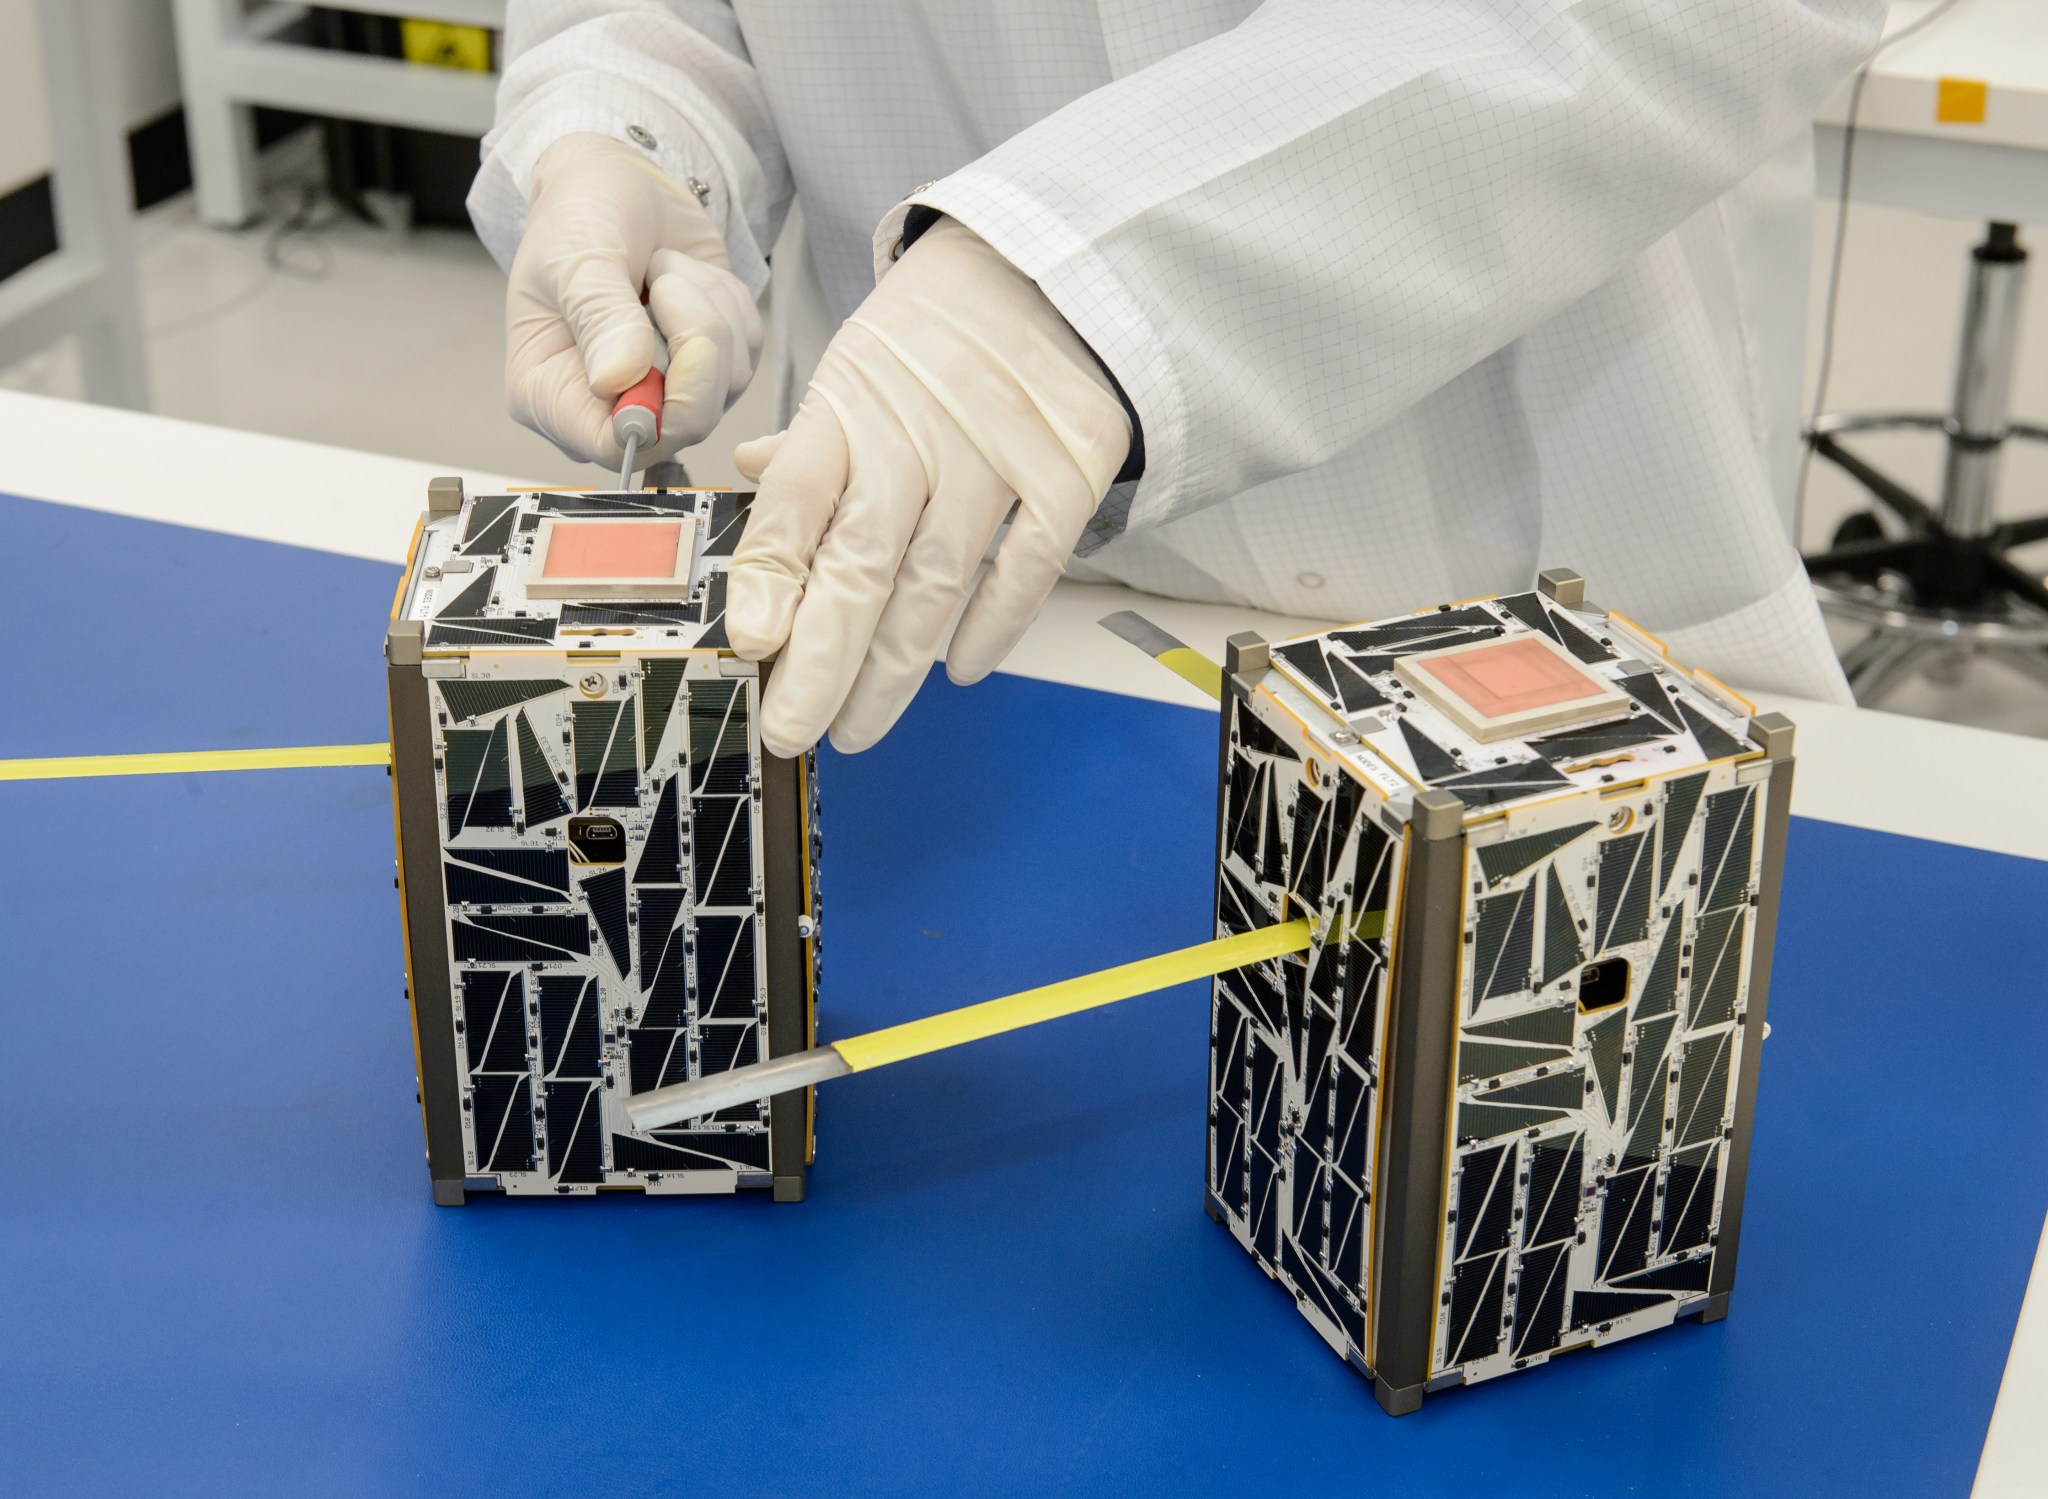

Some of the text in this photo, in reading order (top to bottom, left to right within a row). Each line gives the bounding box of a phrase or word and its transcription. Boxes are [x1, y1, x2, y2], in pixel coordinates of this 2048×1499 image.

[422, 589, 434, 603] NODES
[540, 736, 552, 753] SL33
[550, 755, 561, 768] D33
[671, 759, 678, 768] D9
[1357, 755, 1400, 788] NODES FLT2
[439, 802, 447, 820] SL29
[757, 918, 764, 927] D4
[1435, 1347, 1443, 1364] SL18
